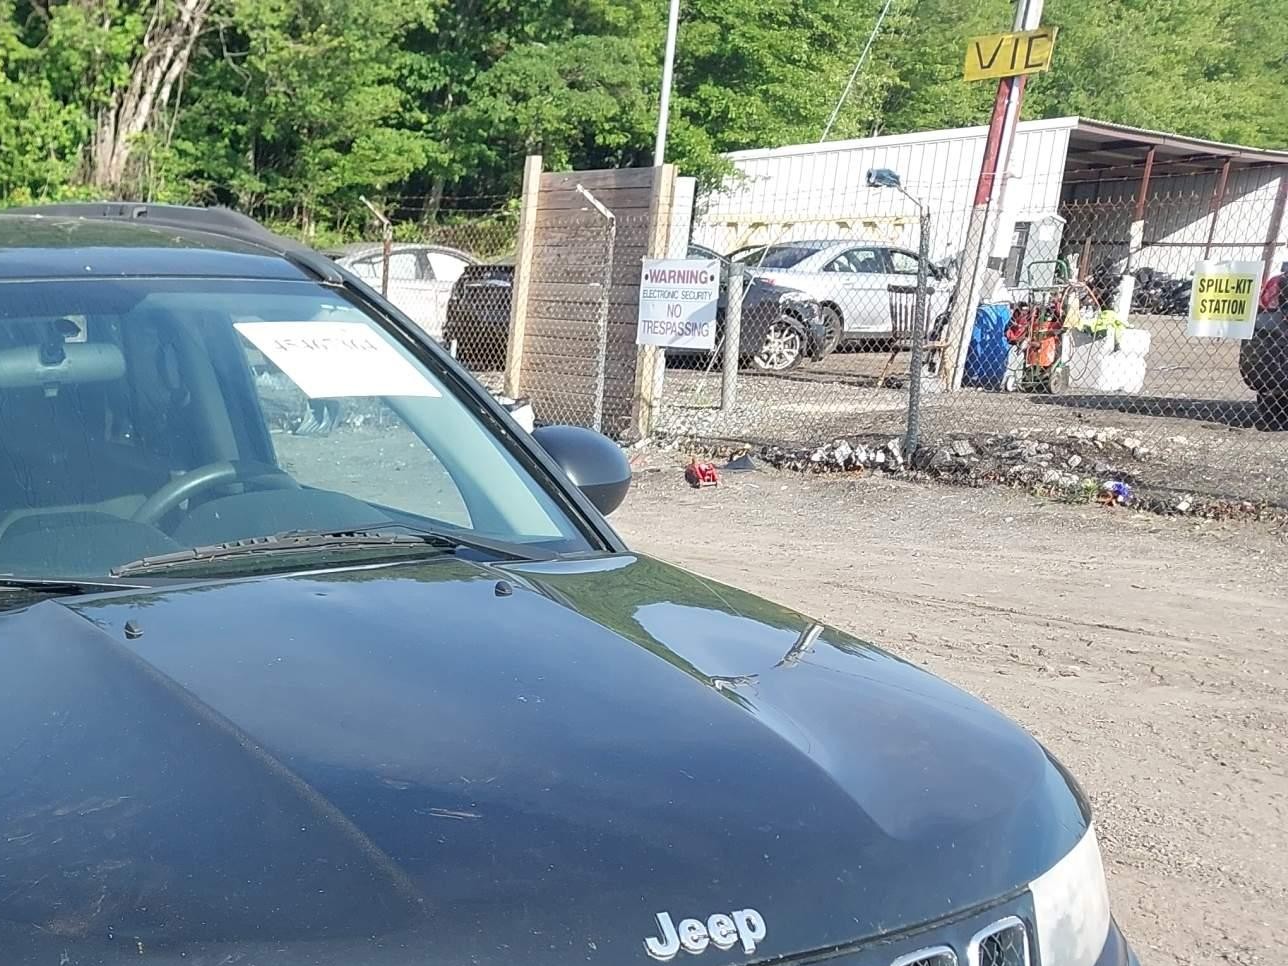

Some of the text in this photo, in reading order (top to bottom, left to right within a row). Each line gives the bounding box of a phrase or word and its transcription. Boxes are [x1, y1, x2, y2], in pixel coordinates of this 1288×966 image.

[975, 33, 1049, 70] VIC
[649, 268, 709, 285] WARNING
[1198, 278, 1253, 294] SPILL-KIT
[642, 289, 713, 300] ELECTRONIC SECURITY
[666, 303, 682, 318] NO
[1199, 299, 1246, 315] STATION
[641, 319, 710, 337] TRESPASSING
[643, 908, 767, 961] Jeep
